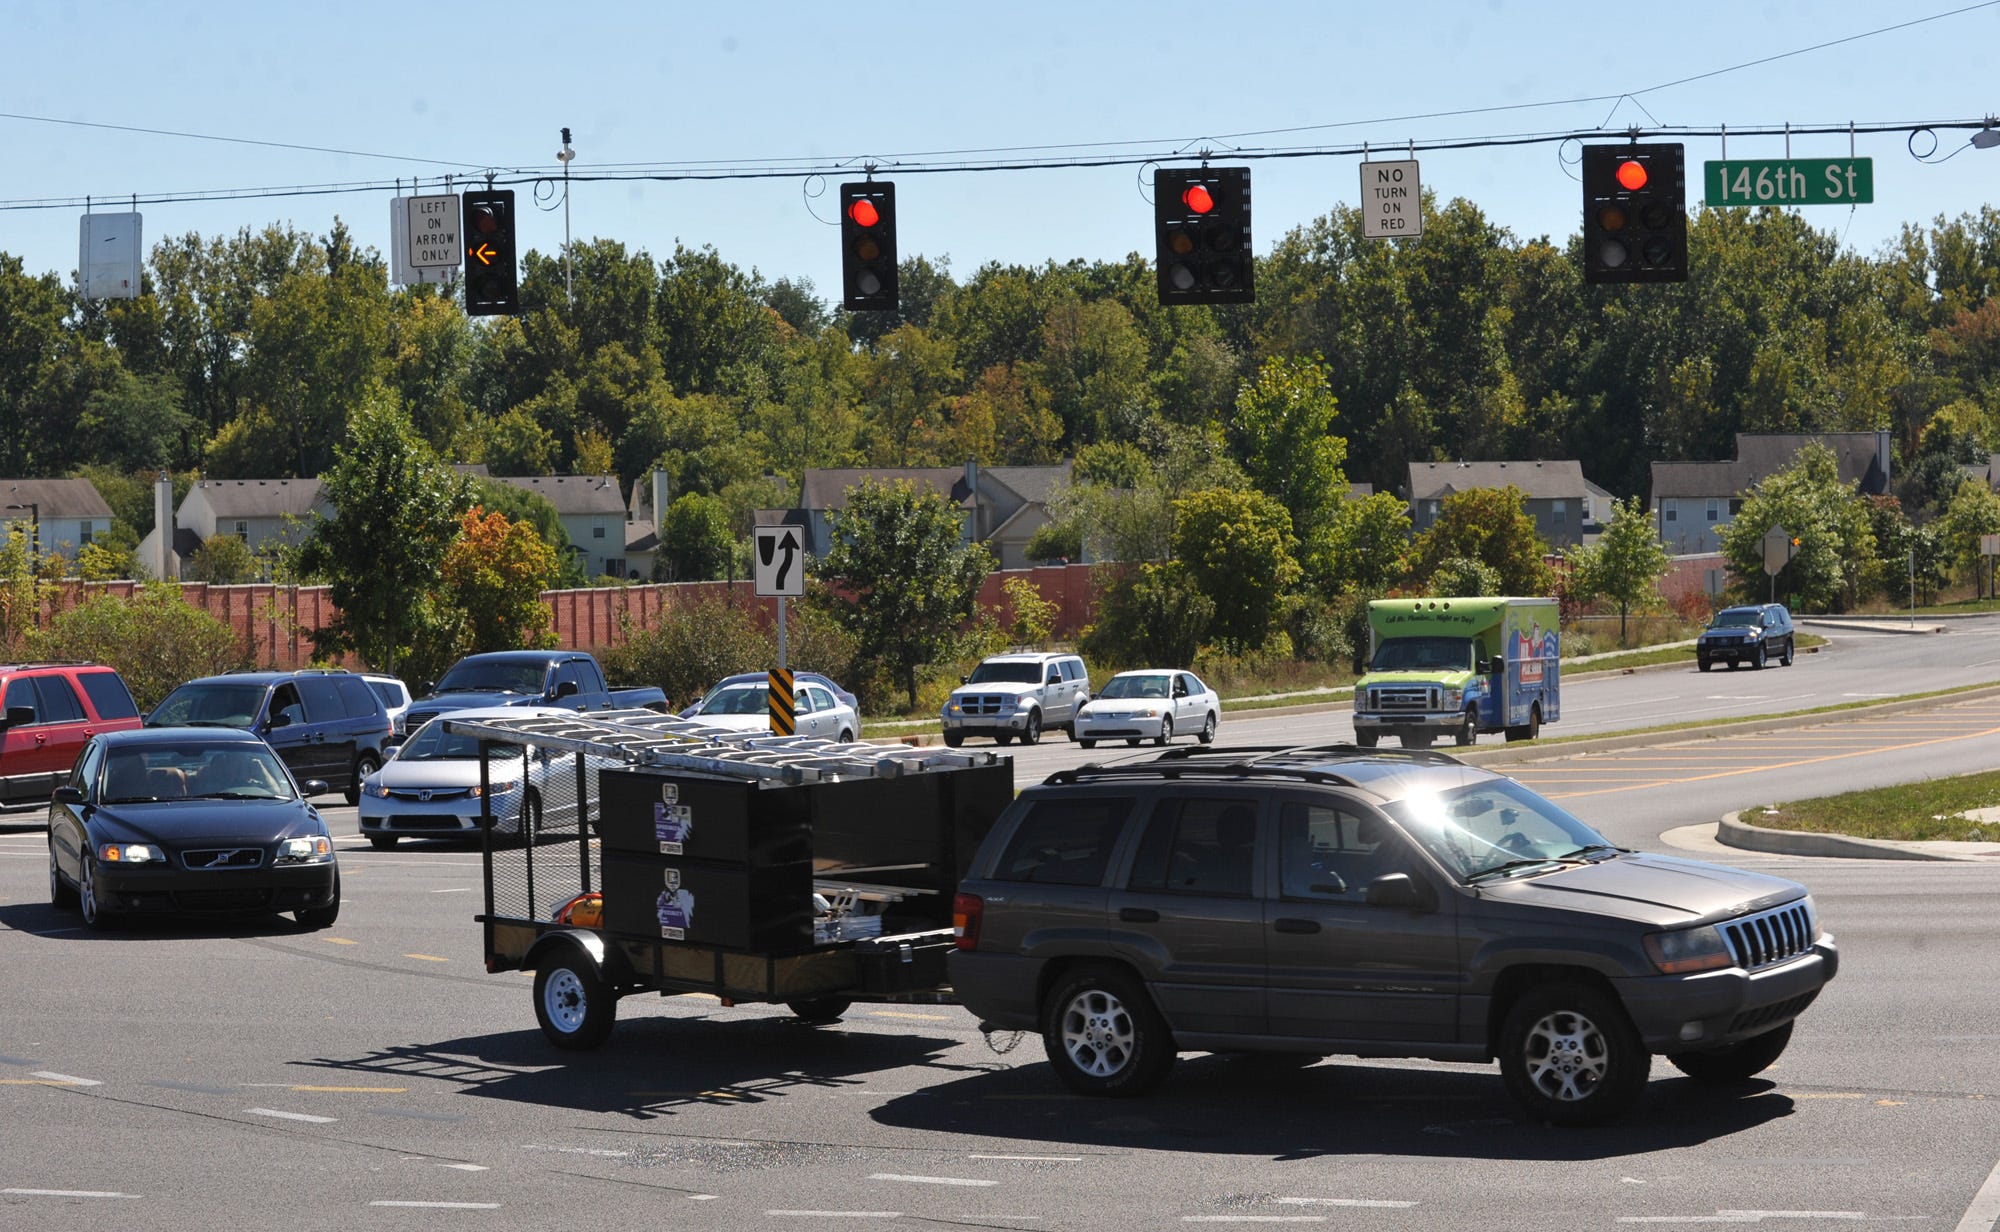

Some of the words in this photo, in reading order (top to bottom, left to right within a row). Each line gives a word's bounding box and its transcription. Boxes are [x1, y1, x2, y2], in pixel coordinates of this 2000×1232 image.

[1378, 168, 1403, 183] NO
[1720, 166, 1806, 200] 146th
[1825, 164, 1857, 199] St
[1374, 186, 1407, 199] TURN
[420, 202, 446, 214] LEFT
[1383, 202, 1401, 214] ON
[428, 218, 441, 229] ON
[1381, 218, 1405, 230] RED
[416, 233, 454, 245] ARROW
[422, 249, 449, 261] ONLY
